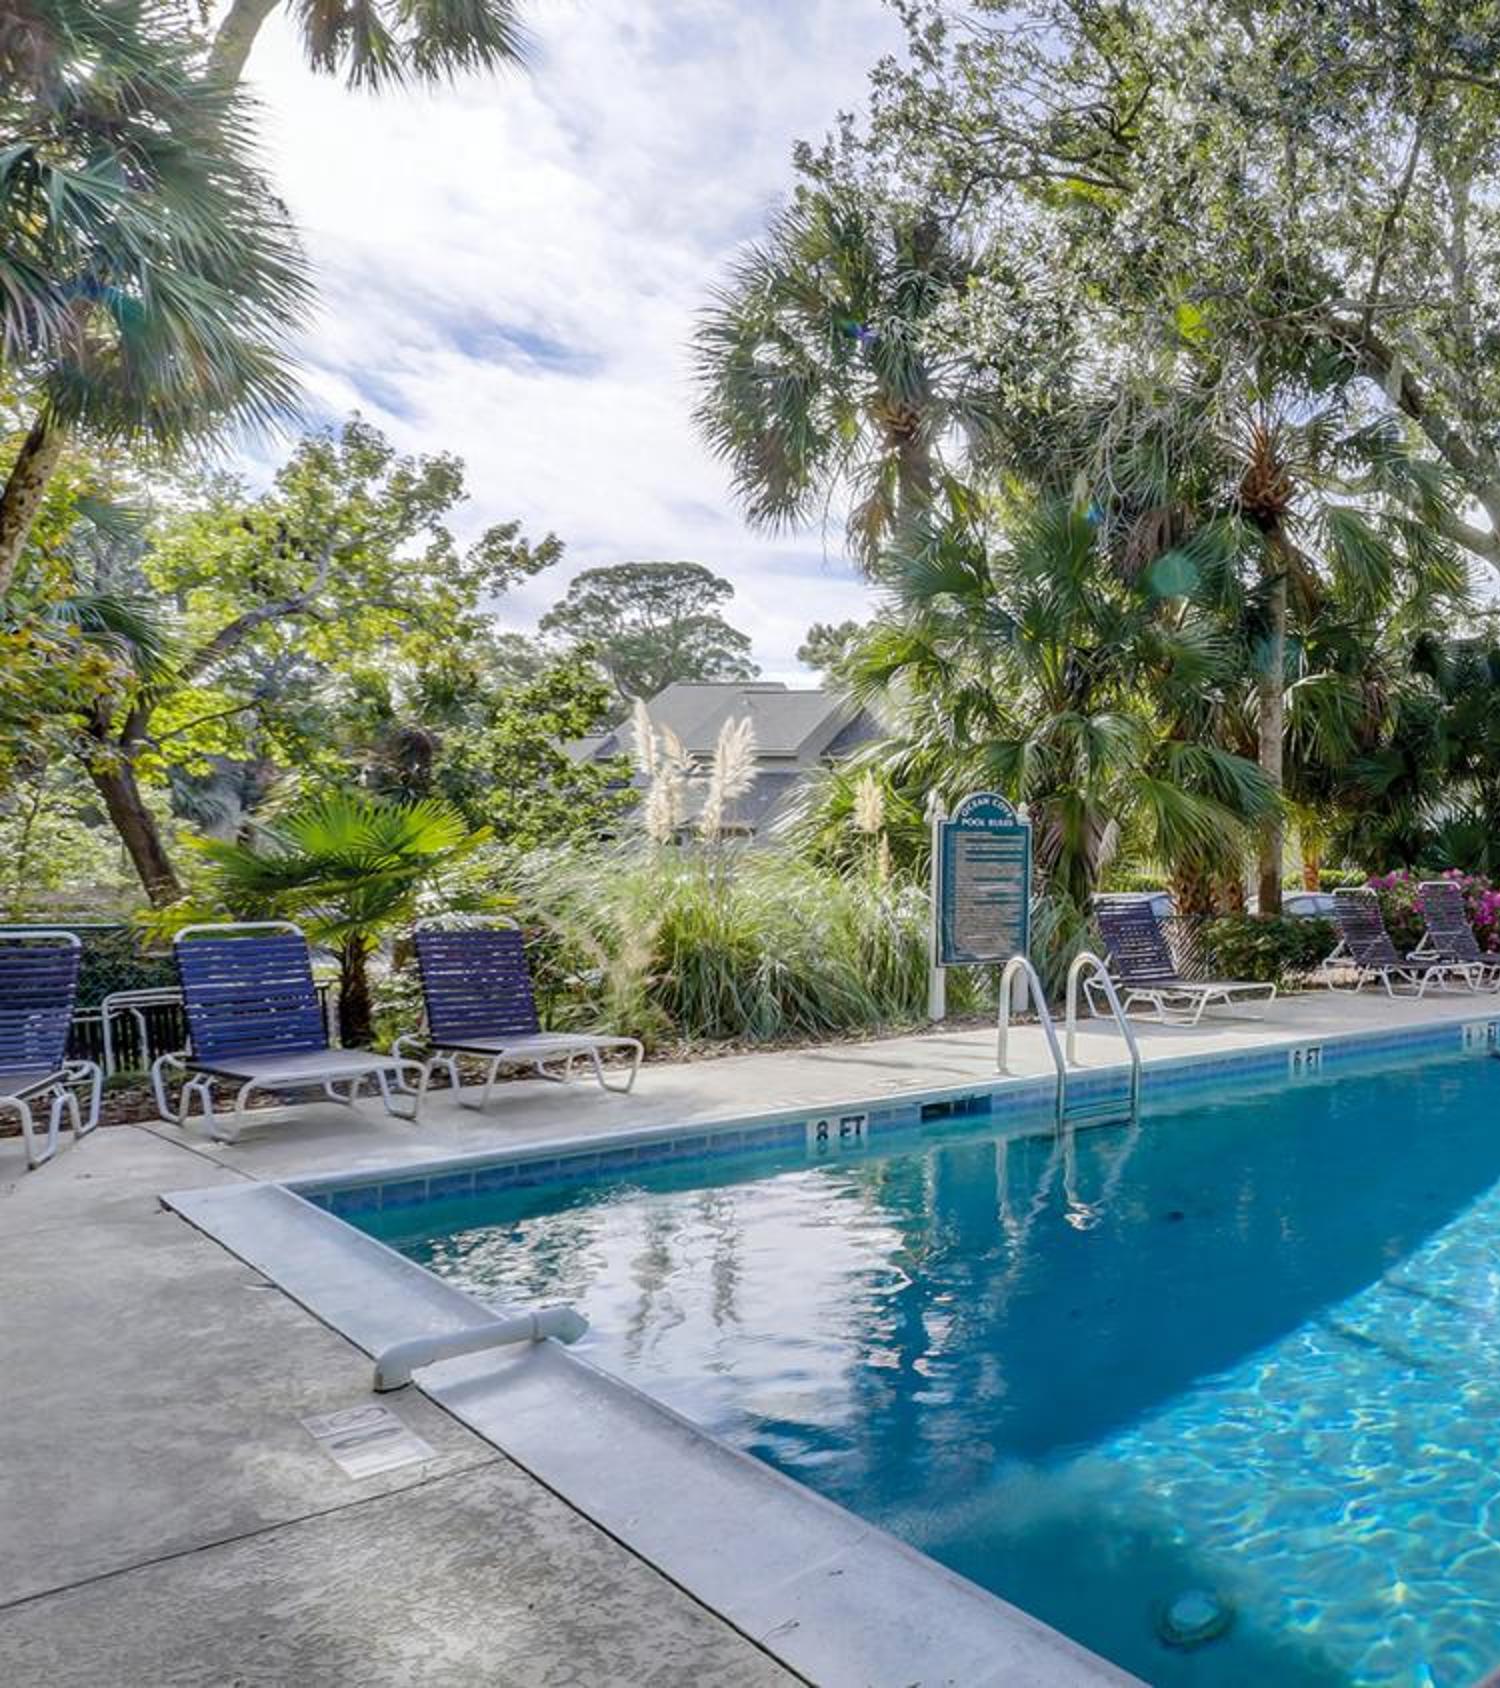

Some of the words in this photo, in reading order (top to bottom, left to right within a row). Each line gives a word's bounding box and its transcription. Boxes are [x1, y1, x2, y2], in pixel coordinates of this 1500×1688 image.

[961, 818, 985, 827] POOL
[1307, 1047, 1321, 1066] FT
[840, 1115, 865, 1137] FT
